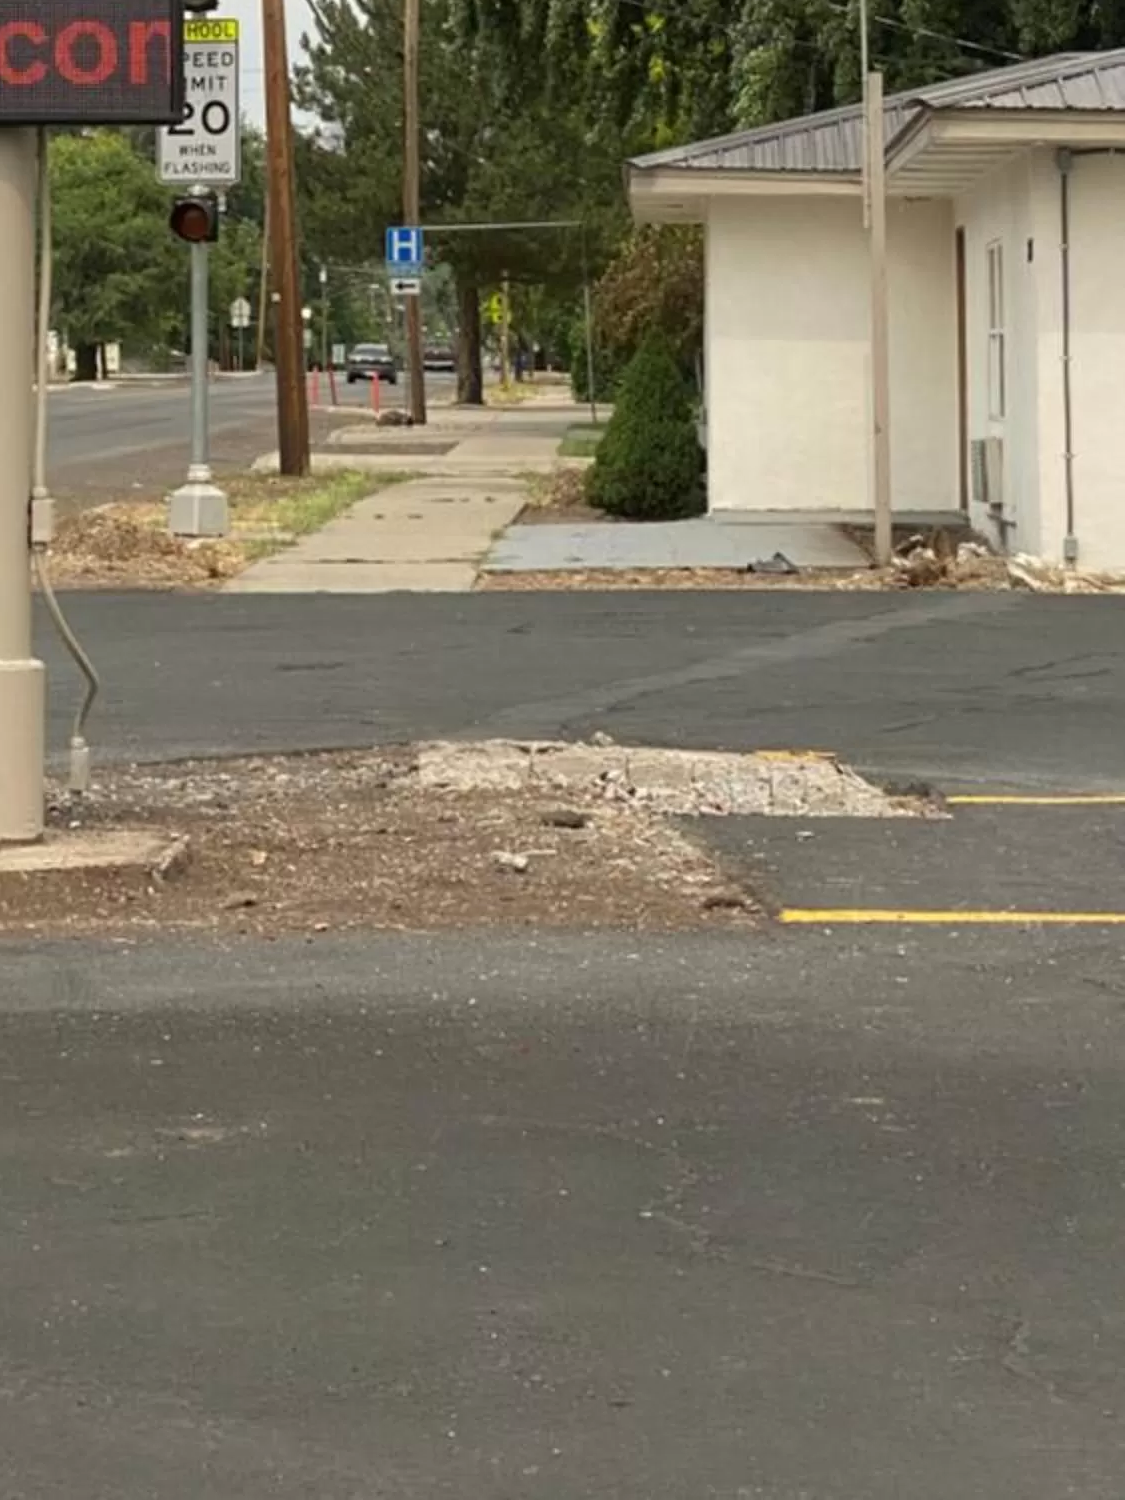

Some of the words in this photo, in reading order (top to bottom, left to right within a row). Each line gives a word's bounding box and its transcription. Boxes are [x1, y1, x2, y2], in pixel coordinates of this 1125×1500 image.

[186, 23, 234, 38] HOOL
[190, 75, 227, 92] MIT
[167, 100, 230, 135] 20
[178, 144, 217, 157] WHEN
[163, 161, 231, 175] FLASHING
[393, 230, 417, 263] H
